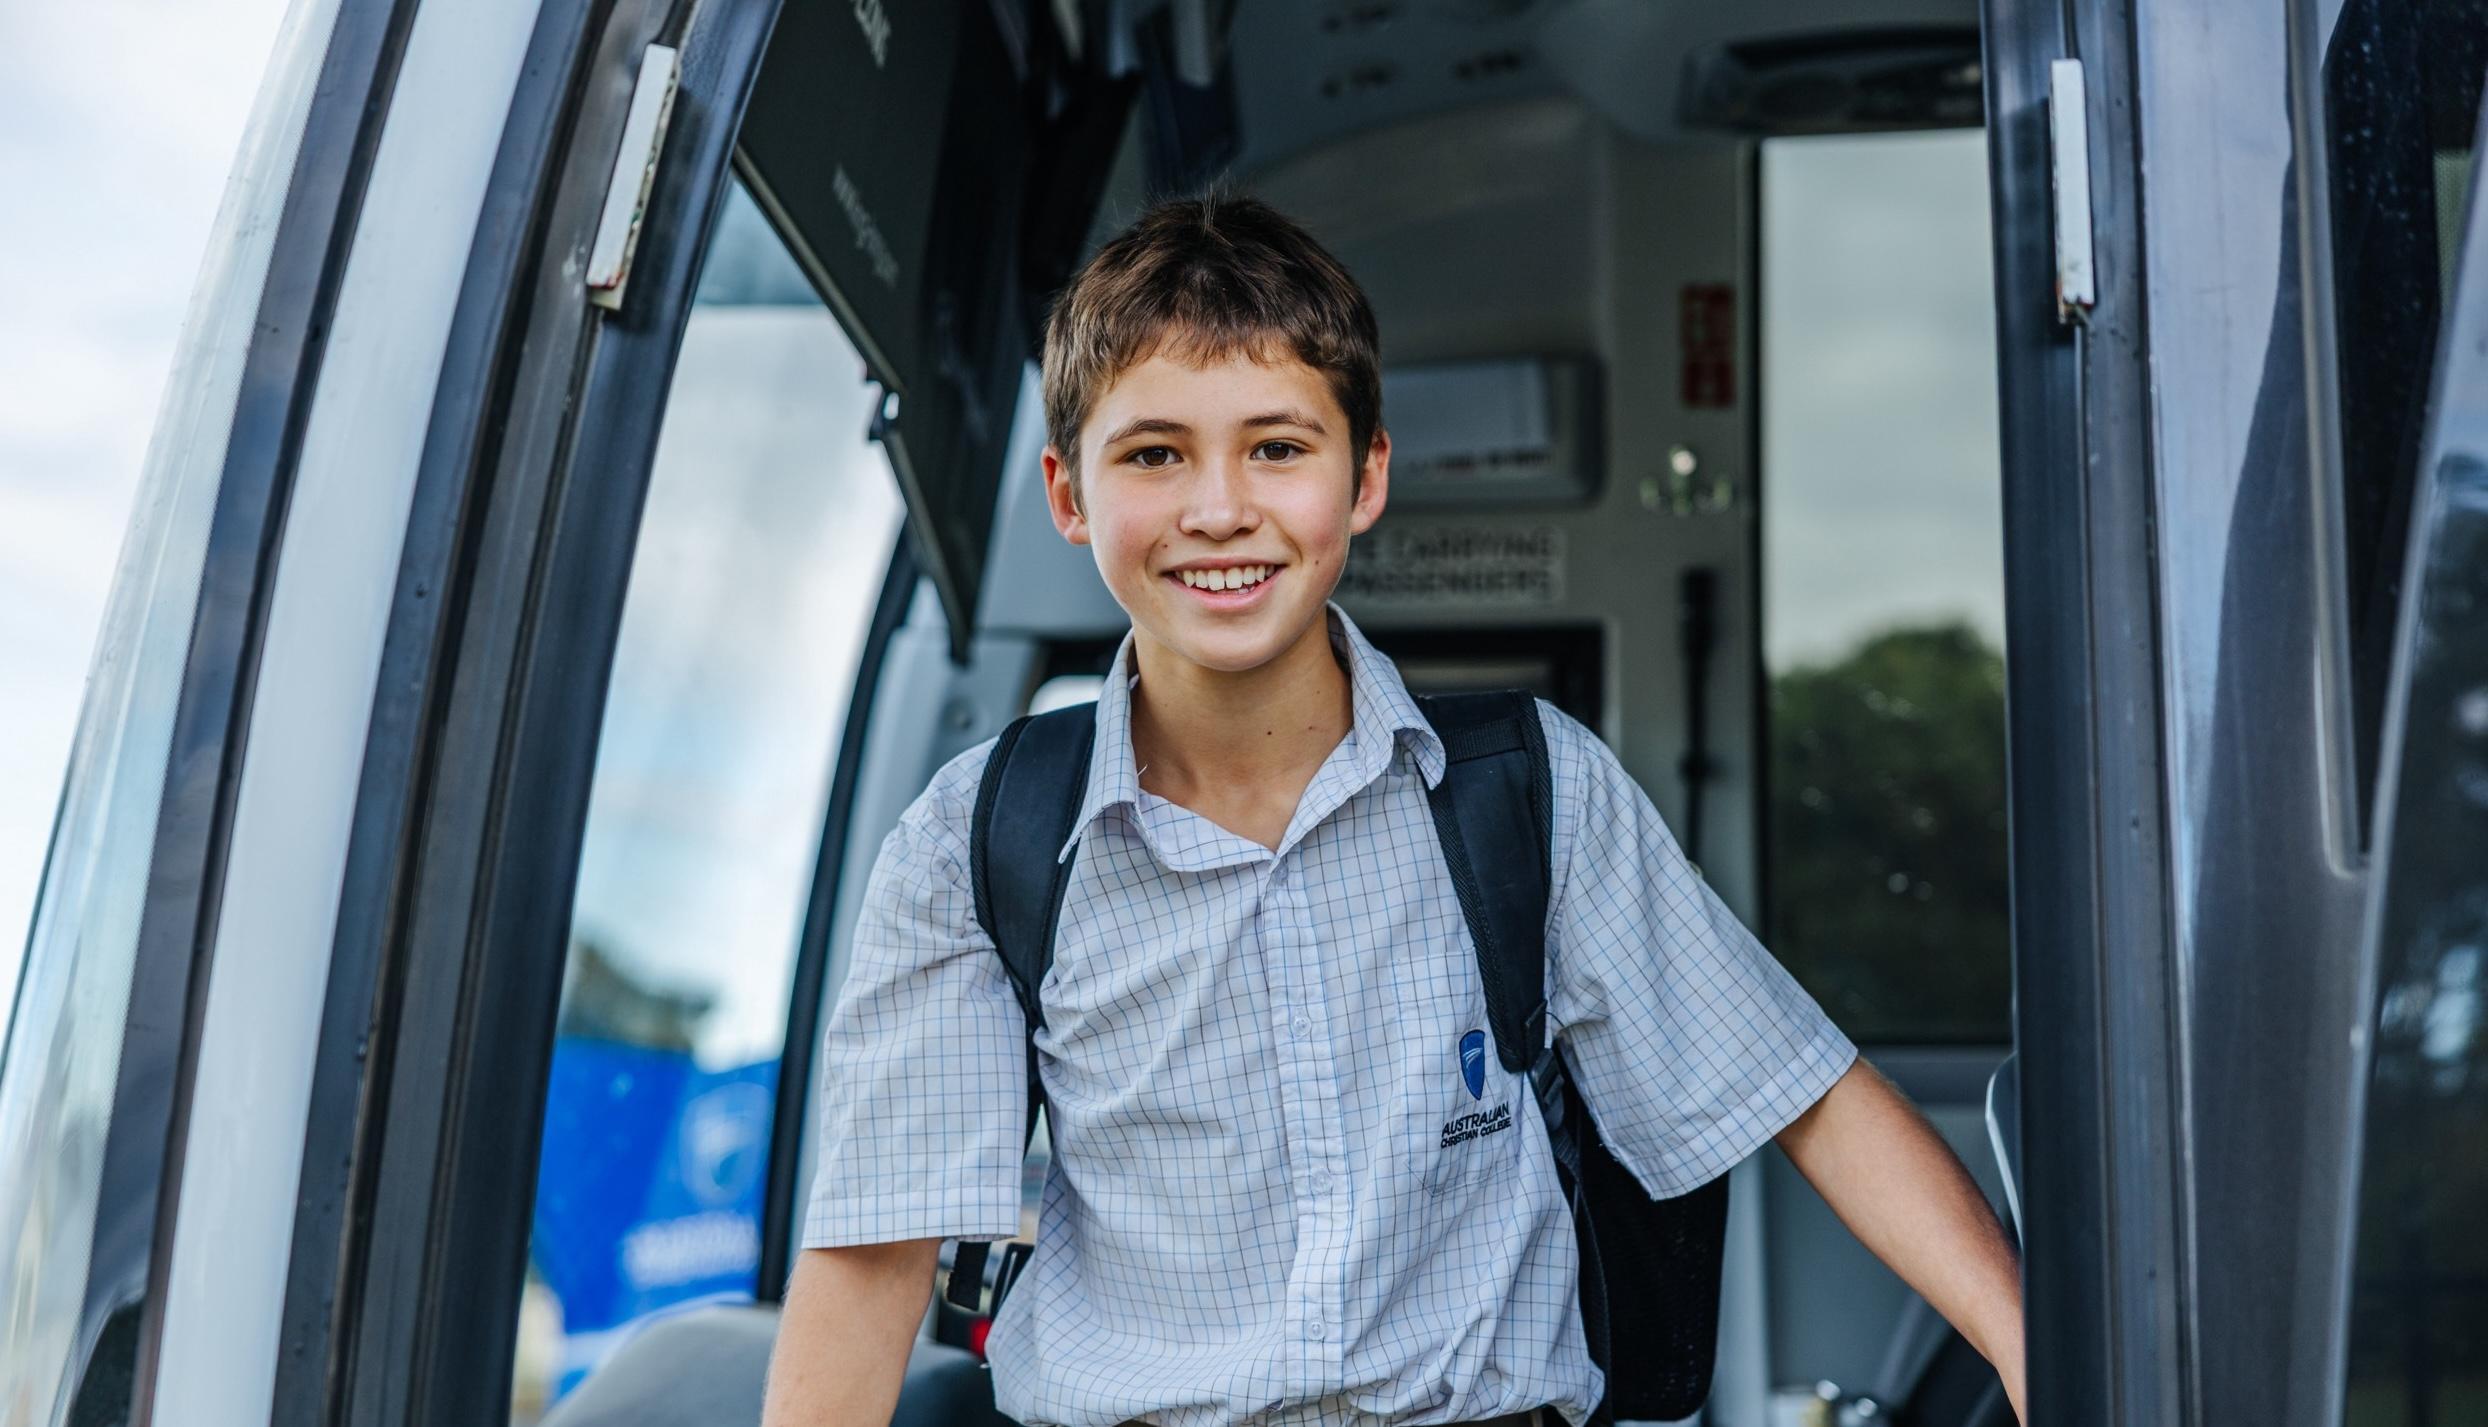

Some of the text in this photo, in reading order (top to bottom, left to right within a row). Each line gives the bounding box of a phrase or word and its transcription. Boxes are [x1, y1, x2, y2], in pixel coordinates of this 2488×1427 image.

[1440, 1117, 1512, 1149] CHRISTIAN COLLEGE
[1441, 1101, 1510, 1138] AUSTRALIAN
